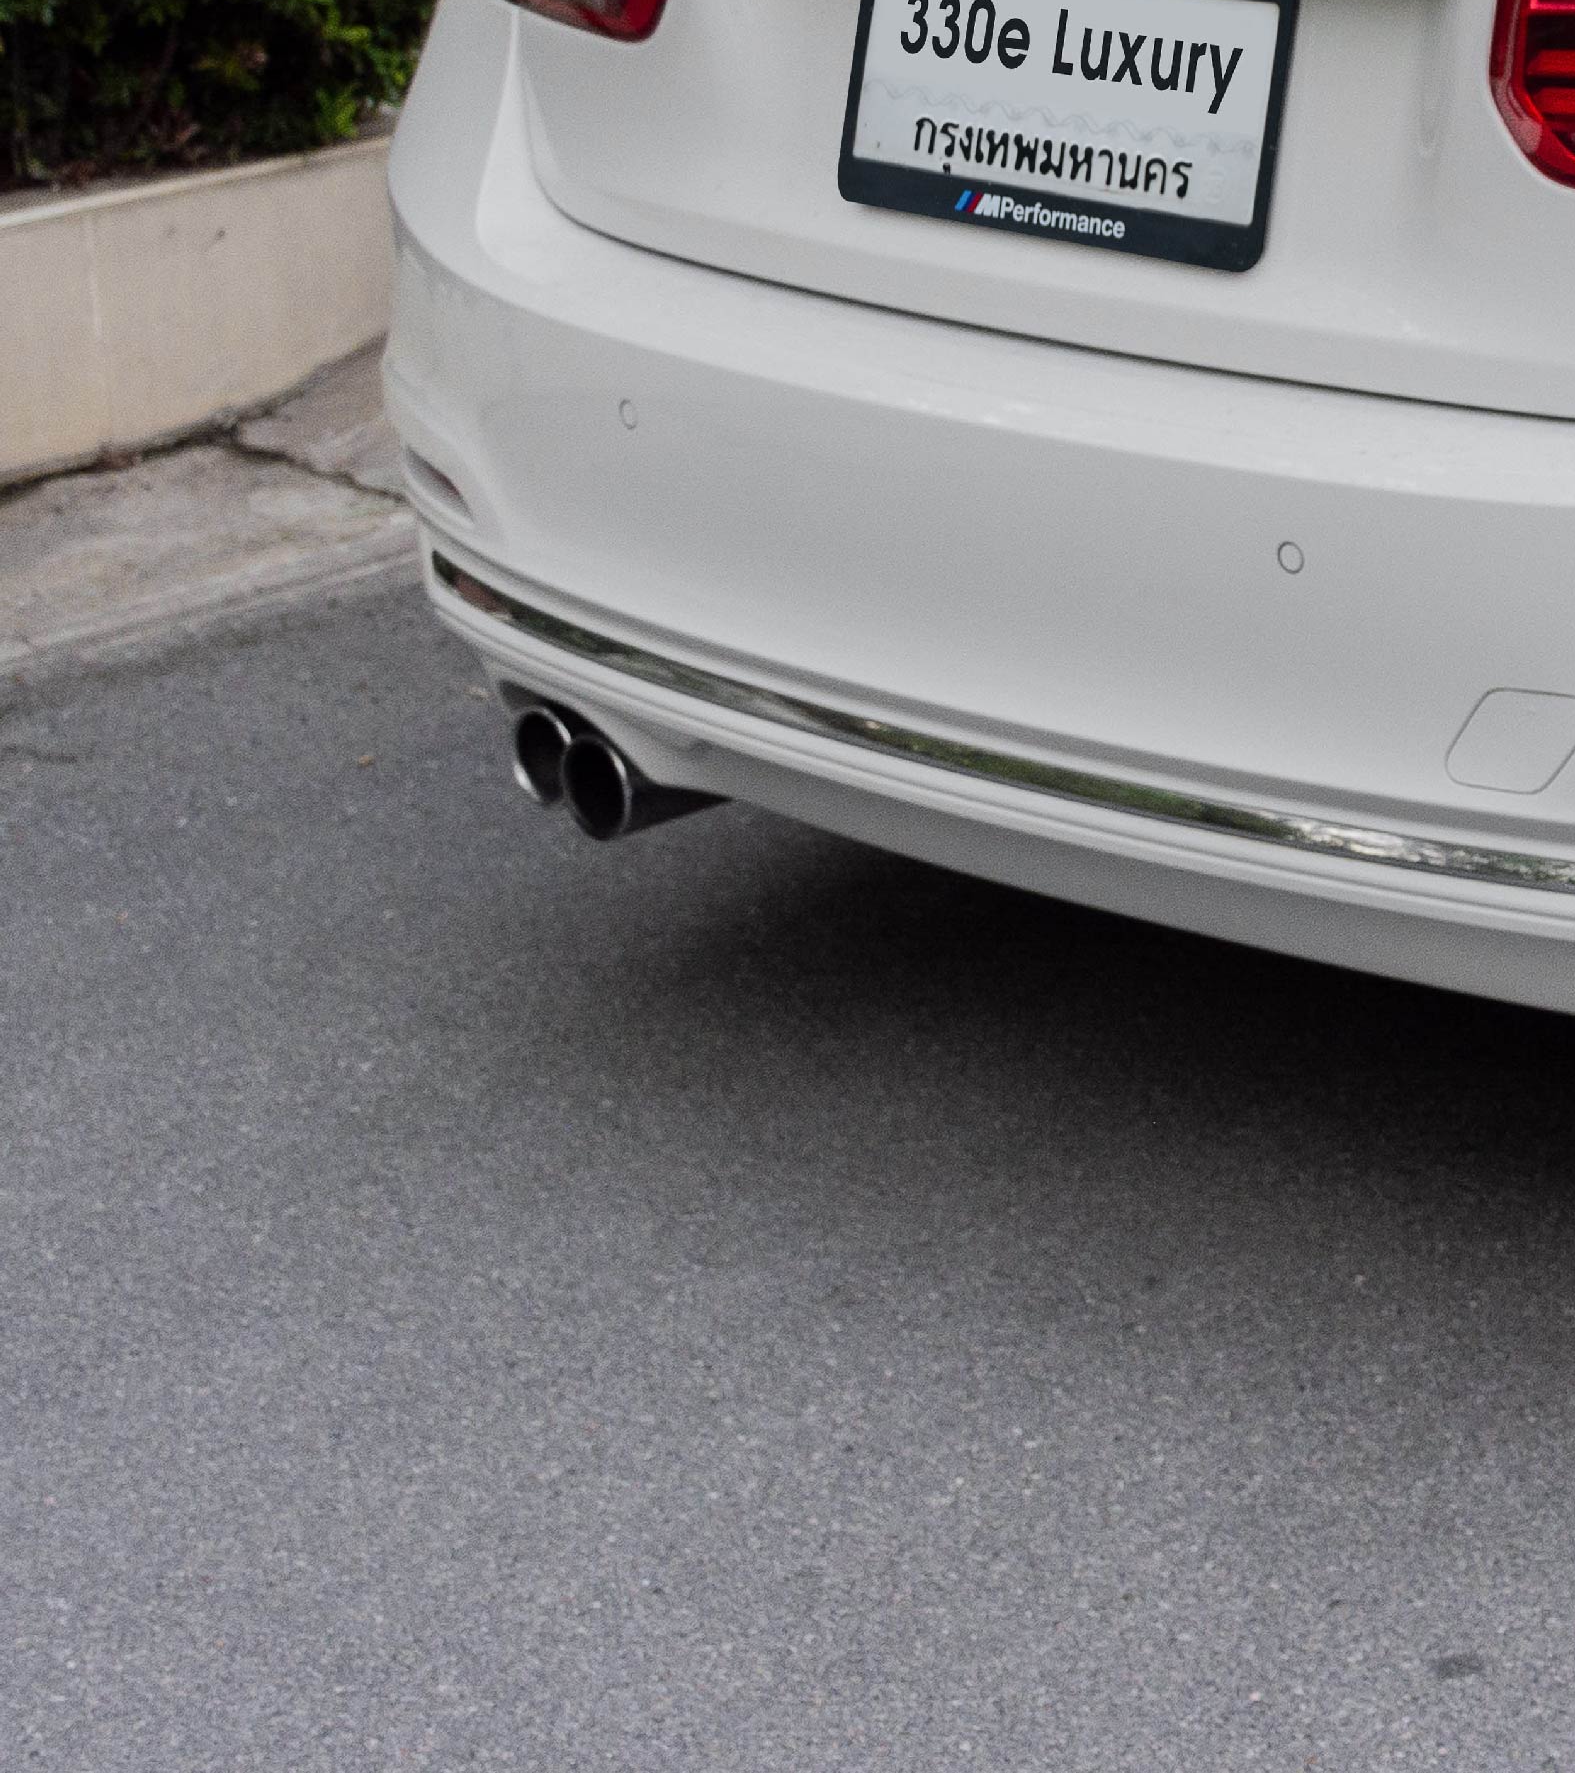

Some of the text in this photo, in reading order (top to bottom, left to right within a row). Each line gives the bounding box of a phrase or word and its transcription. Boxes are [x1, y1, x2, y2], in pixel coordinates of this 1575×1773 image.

[1051, 8, 1244, 115] Luxury
[913, 116, 1194, 199] กรุงเทพมหานคร
